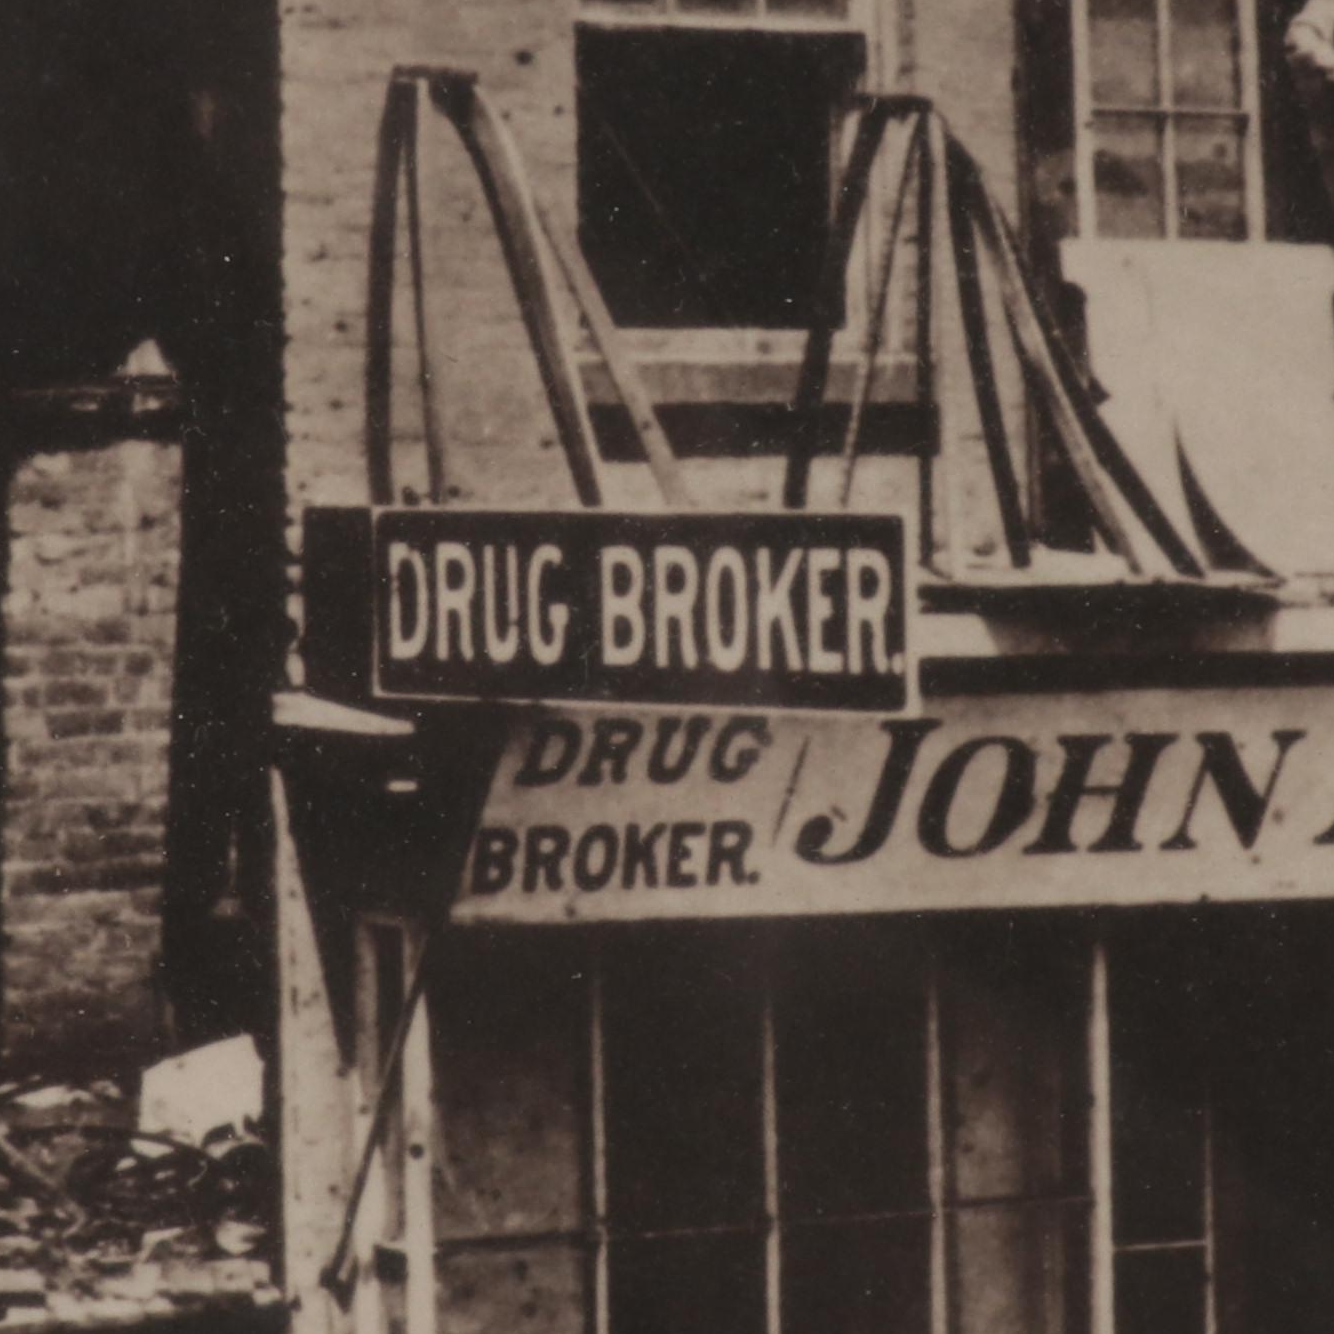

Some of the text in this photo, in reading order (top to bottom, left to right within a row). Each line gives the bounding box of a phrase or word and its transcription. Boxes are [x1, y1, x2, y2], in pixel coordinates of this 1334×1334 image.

[387, 542, 905, 674] DRUG BROKER.
[513, 715, 774, 788] DRUG
[794, 715, 1306, 867] JOHN
[469, 820, 761, 895] BROKER.
